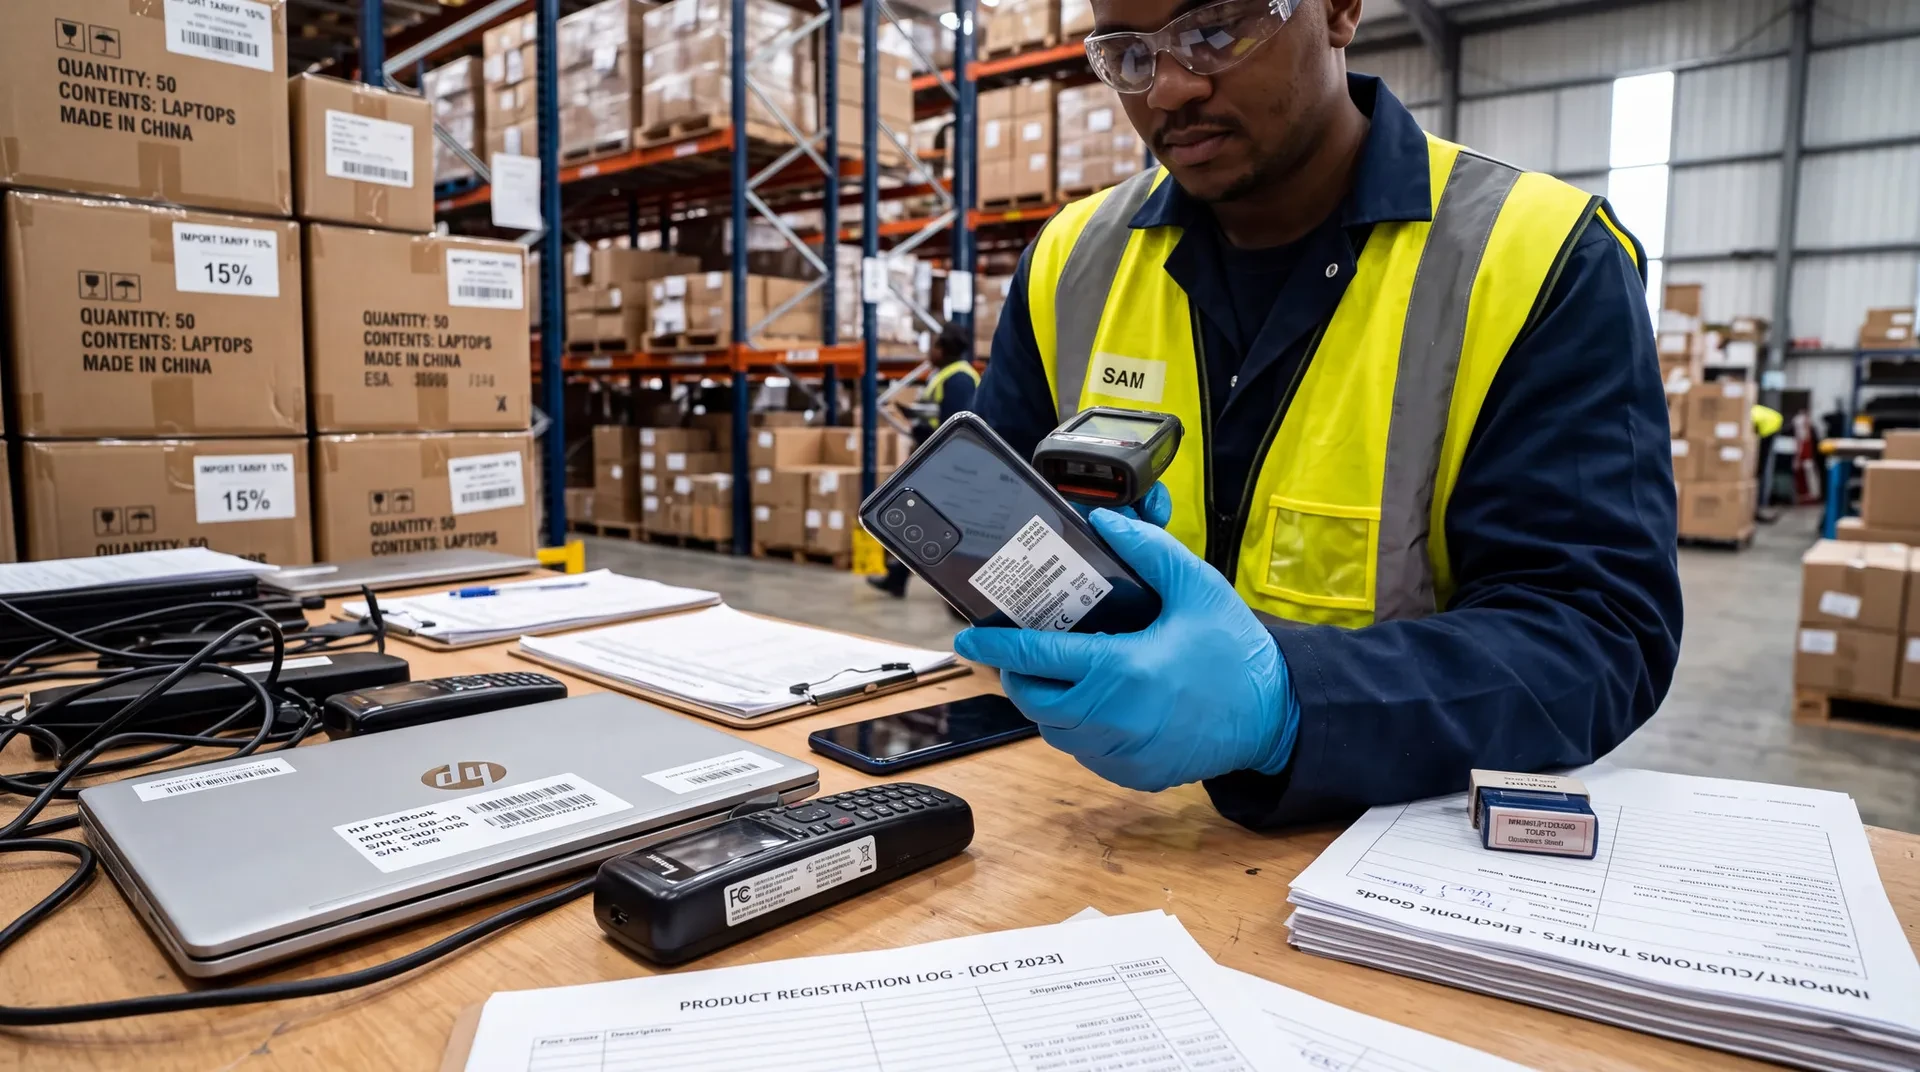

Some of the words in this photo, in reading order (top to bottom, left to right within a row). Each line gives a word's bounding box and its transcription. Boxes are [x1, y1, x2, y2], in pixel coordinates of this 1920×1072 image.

[58, 57, 151, 89] QUANTITY:
[156, 75, 176, 93] 50
[59, 82, 156, 112] CONTENTS:
[162, 98, 236, 125] LAPTOPS
[60, 105, 112, 129] MADE
[119, 115, 136, 132] IN
[142, 118, 193, 141] CHINA
[180, 232, 216, 244] IMPORT
[219, 235, 249, 246] TARIFF
[204, 262, 252, 285] 15%
[80, 308, 170, 328] QUANTITY:
[175, 313, 195, 329] 50
[363, 311, 430, 327] QUANTITY:
[433, 315, 449, 329] 50
[82, 331, 176, 351] CONTENTS:
[182, 336, 253, 353] LAPTOPS
[364, 331, 434, 347] CONTENTS:
[438, 334, 492, 350] LAPTOPS
[83, 354, 133, 372] MADE
[139, 356, 157, 373] IN
[162, 357, 212, 374] CHINA
[364, 351, 402, 366] MADE
[406, 353, 420, 367] IN
[423, 354, 462, 368] CHINA
[1102, 367, 1145, 389] SAM
[200, 464, 235, 474] IMPORT
[222, 489, 270, 512] 15%
[370, 518, 436, 536] QUANTITY:
[440, 516, 456, 531] 50
[371, 536, 438, 556] CONTENTS:
[444, 531, 498, 550] LAPTOPS
[348, 825, 369, 834] HP
[374, 810, 437, 828] ProBook
[358, 826, 415, 842] MODEL:
[365, 839, 397, 850] S/N:
[375, 846, 409, 857] S/N:
[1356, 887, 1415, 909] Goods
[1543, 931, 1630, 958] TARIFFS
[680, 992, 771, 1011] PRODUCT
[778, 975, 911, 1000] REGISTRATION
[916, 970, 953, 983] LOG
[968, 961, 1009, 977] [OCT
[1014, 953, 1064, 969] 2023]
[1637, 951, 1870, 1000] IMPORT/CUSTOMS
